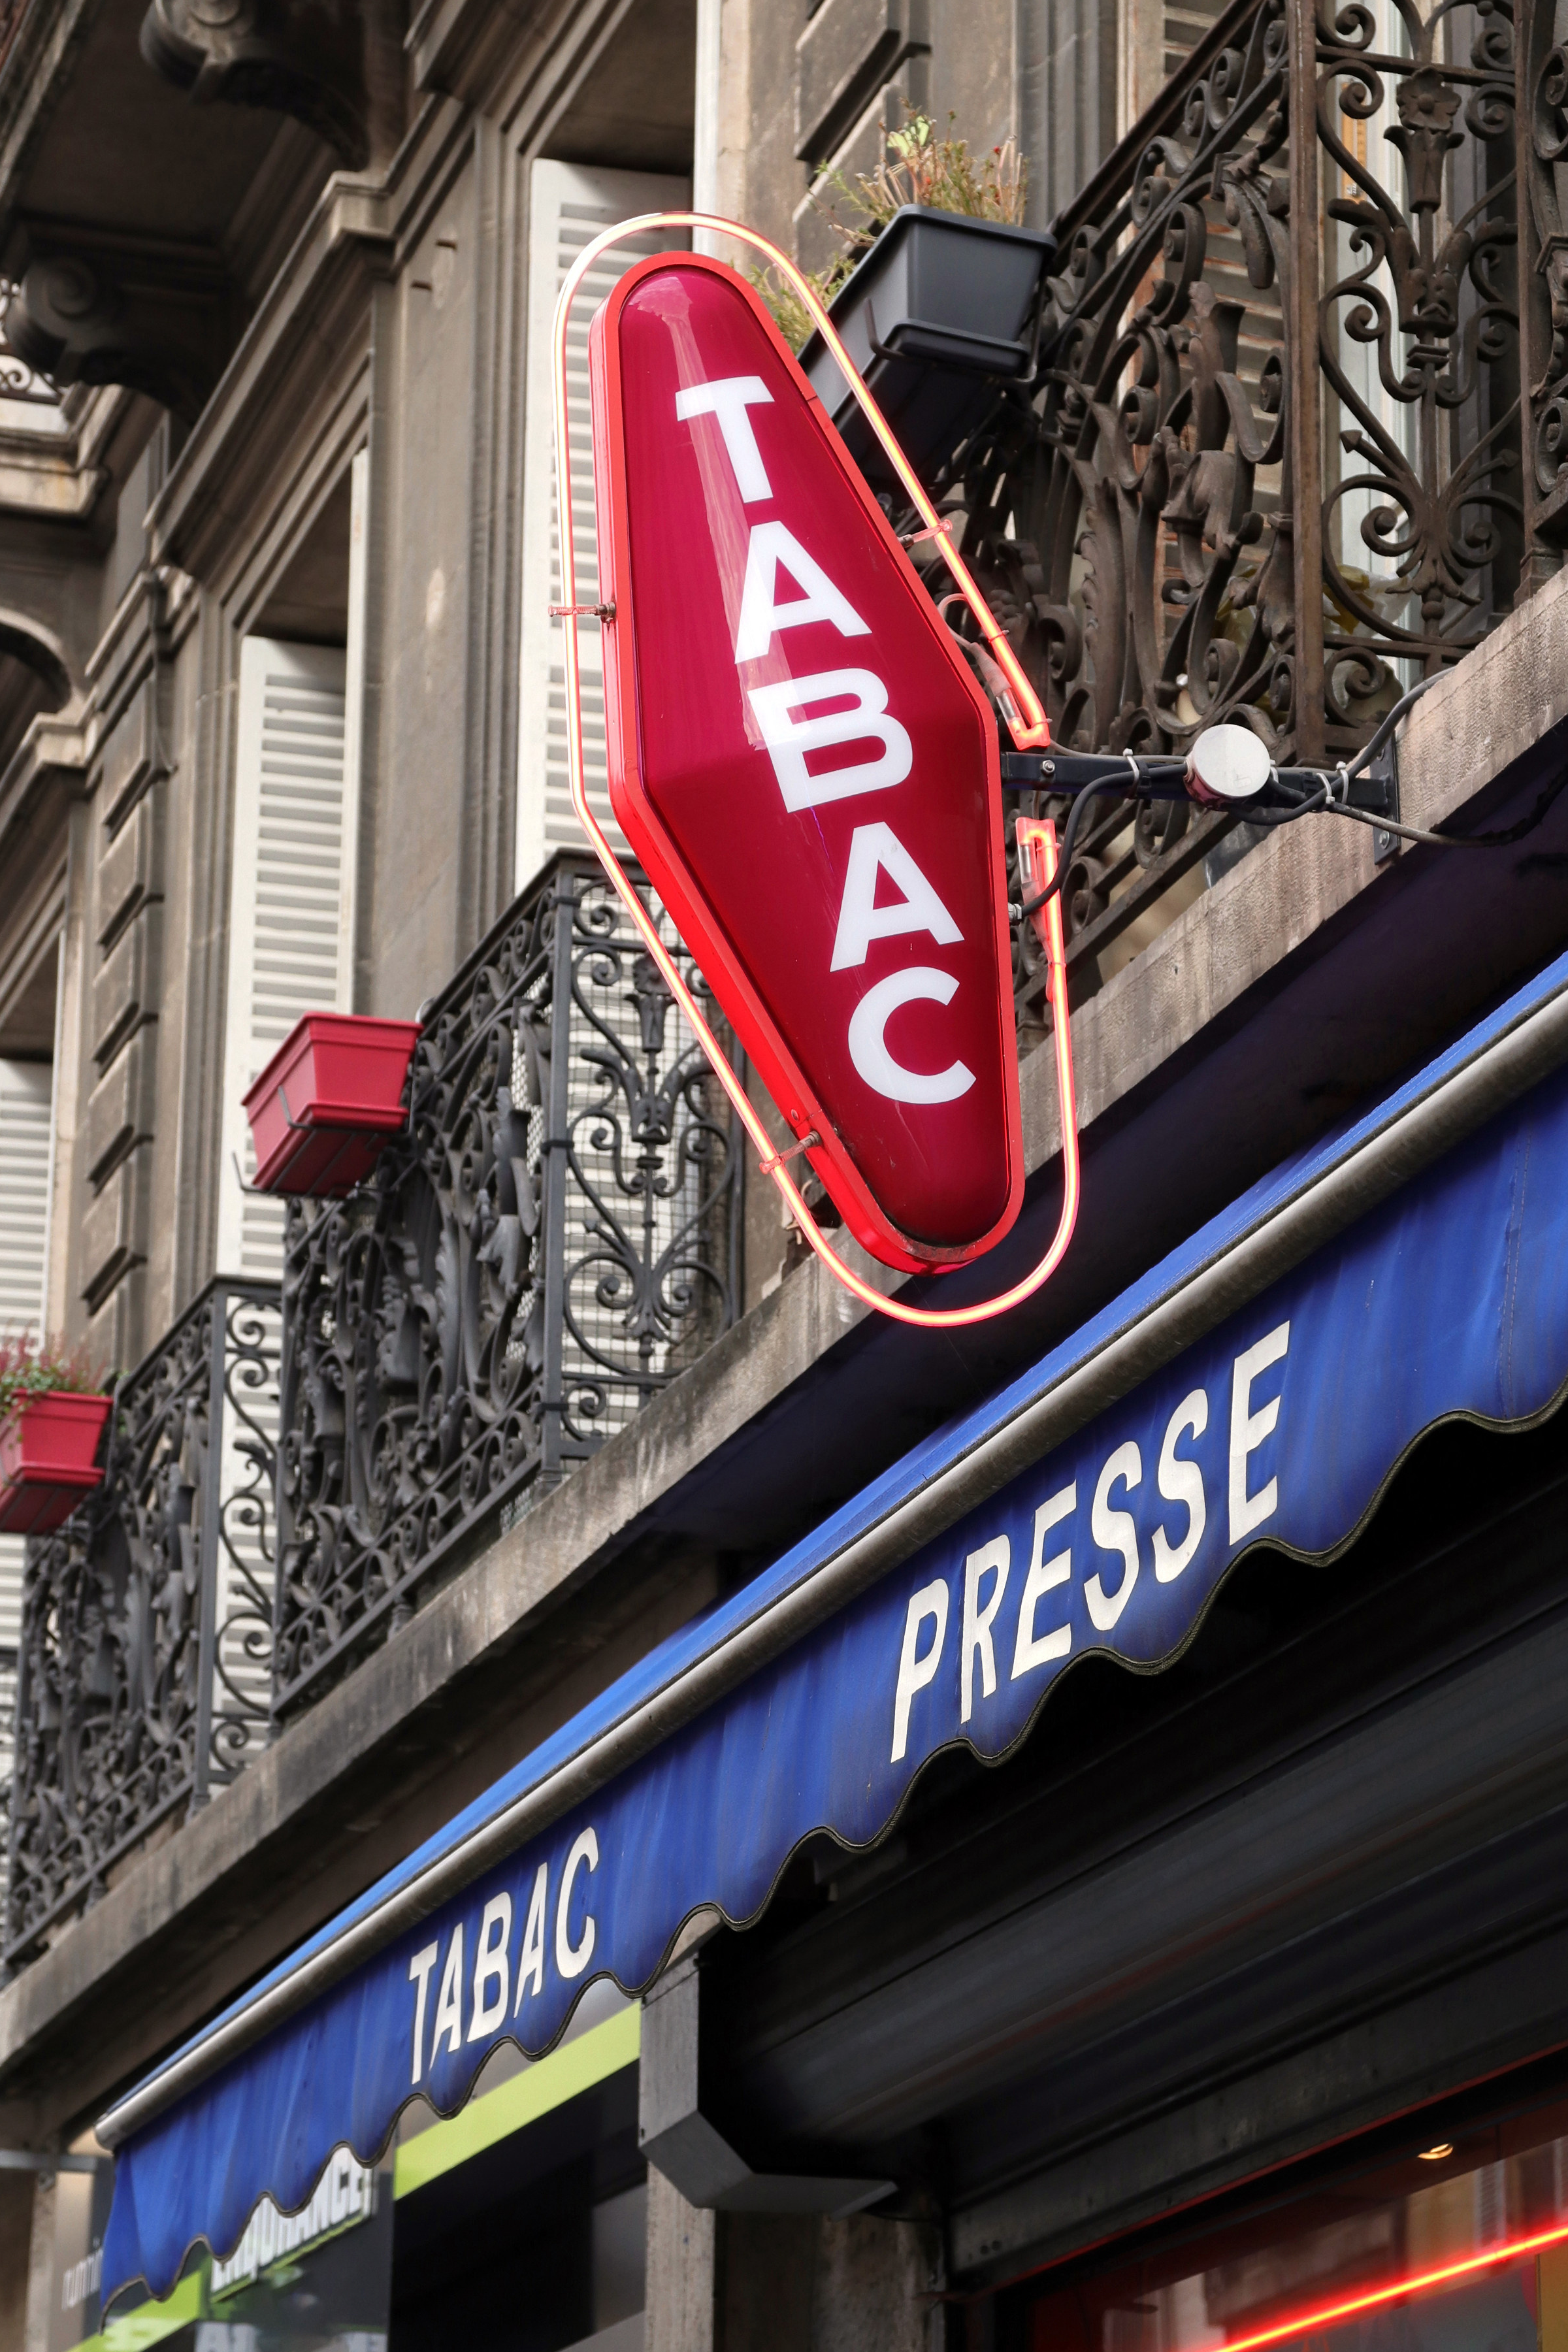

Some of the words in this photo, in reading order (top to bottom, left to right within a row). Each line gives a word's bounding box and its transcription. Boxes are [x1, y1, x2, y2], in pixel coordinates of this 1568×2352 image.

[676, 376, 976, 1104] TABAC
[409, 1827, 598, 2084] TABAC
[890, 1320, 1290, 1763] PRESSE
